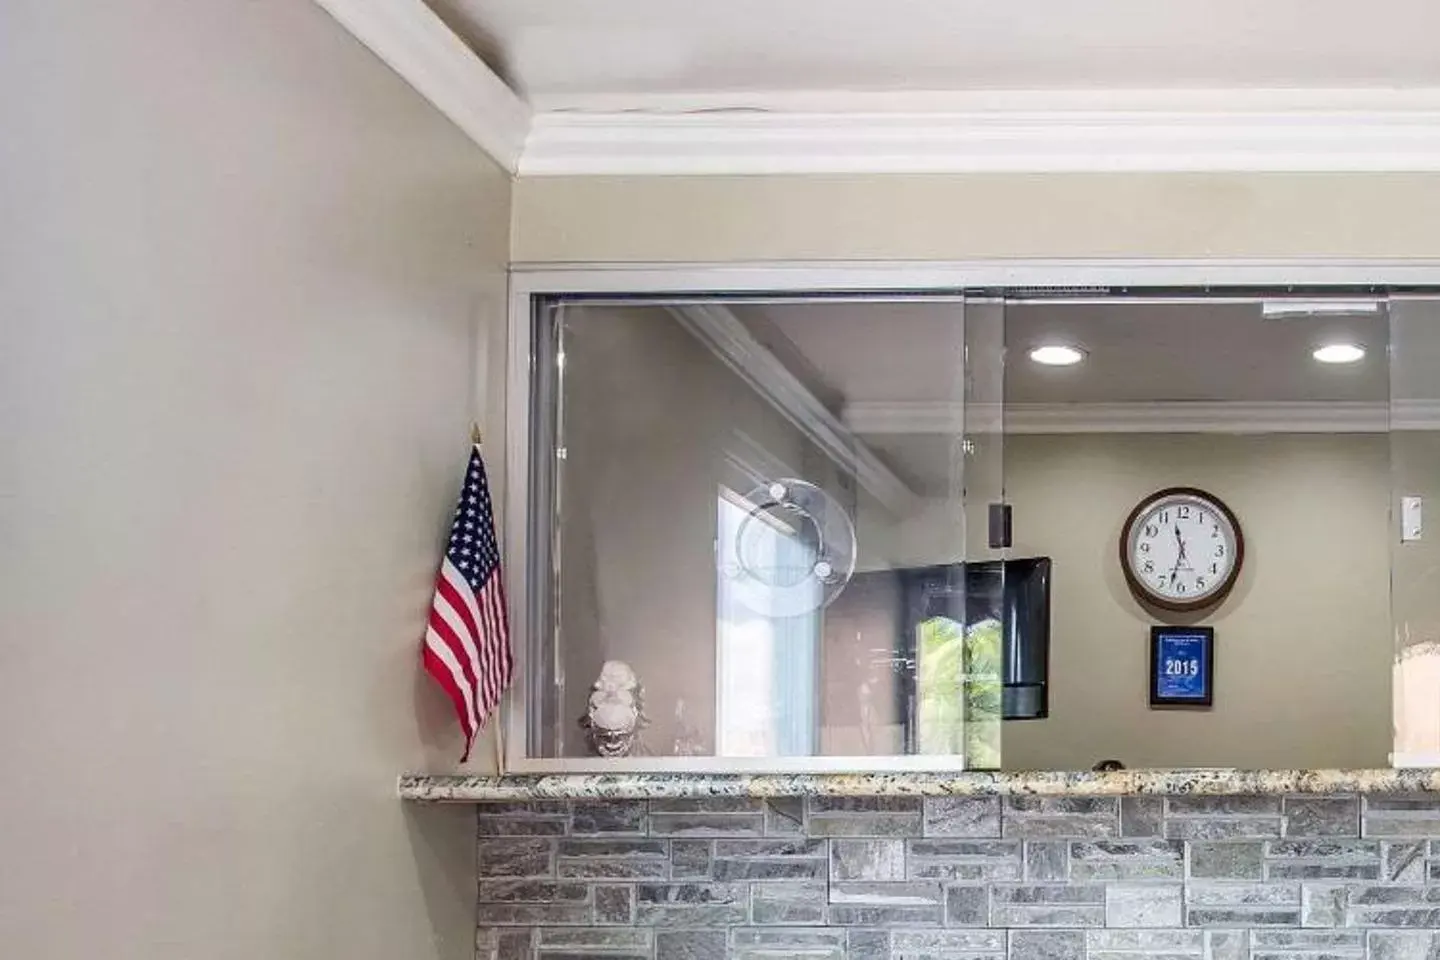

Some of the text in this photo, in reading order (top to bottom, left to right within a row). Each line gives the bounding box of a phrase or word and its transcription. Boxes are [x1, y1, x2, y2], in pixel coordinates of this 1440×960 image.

[1159, 511, 1168, 524] 11
[1175, 506, 1189, 519] 12
[1199, 512, 1204, 524] 1
[1146, 525, 1159, 538] 10
[1211, 524, 1219, 538] 2
[1140, 542, 1150, 553] 9
[1214, 544, 1224, 557] 3
[1144, 560, 1154, 573] 8
[1158, 574, 1167, 588] 7
[1176, 581, 1186, 593] 6
[1196, 576, 1206, 589] 5
[1166, 660, 1199, 676] 2015
